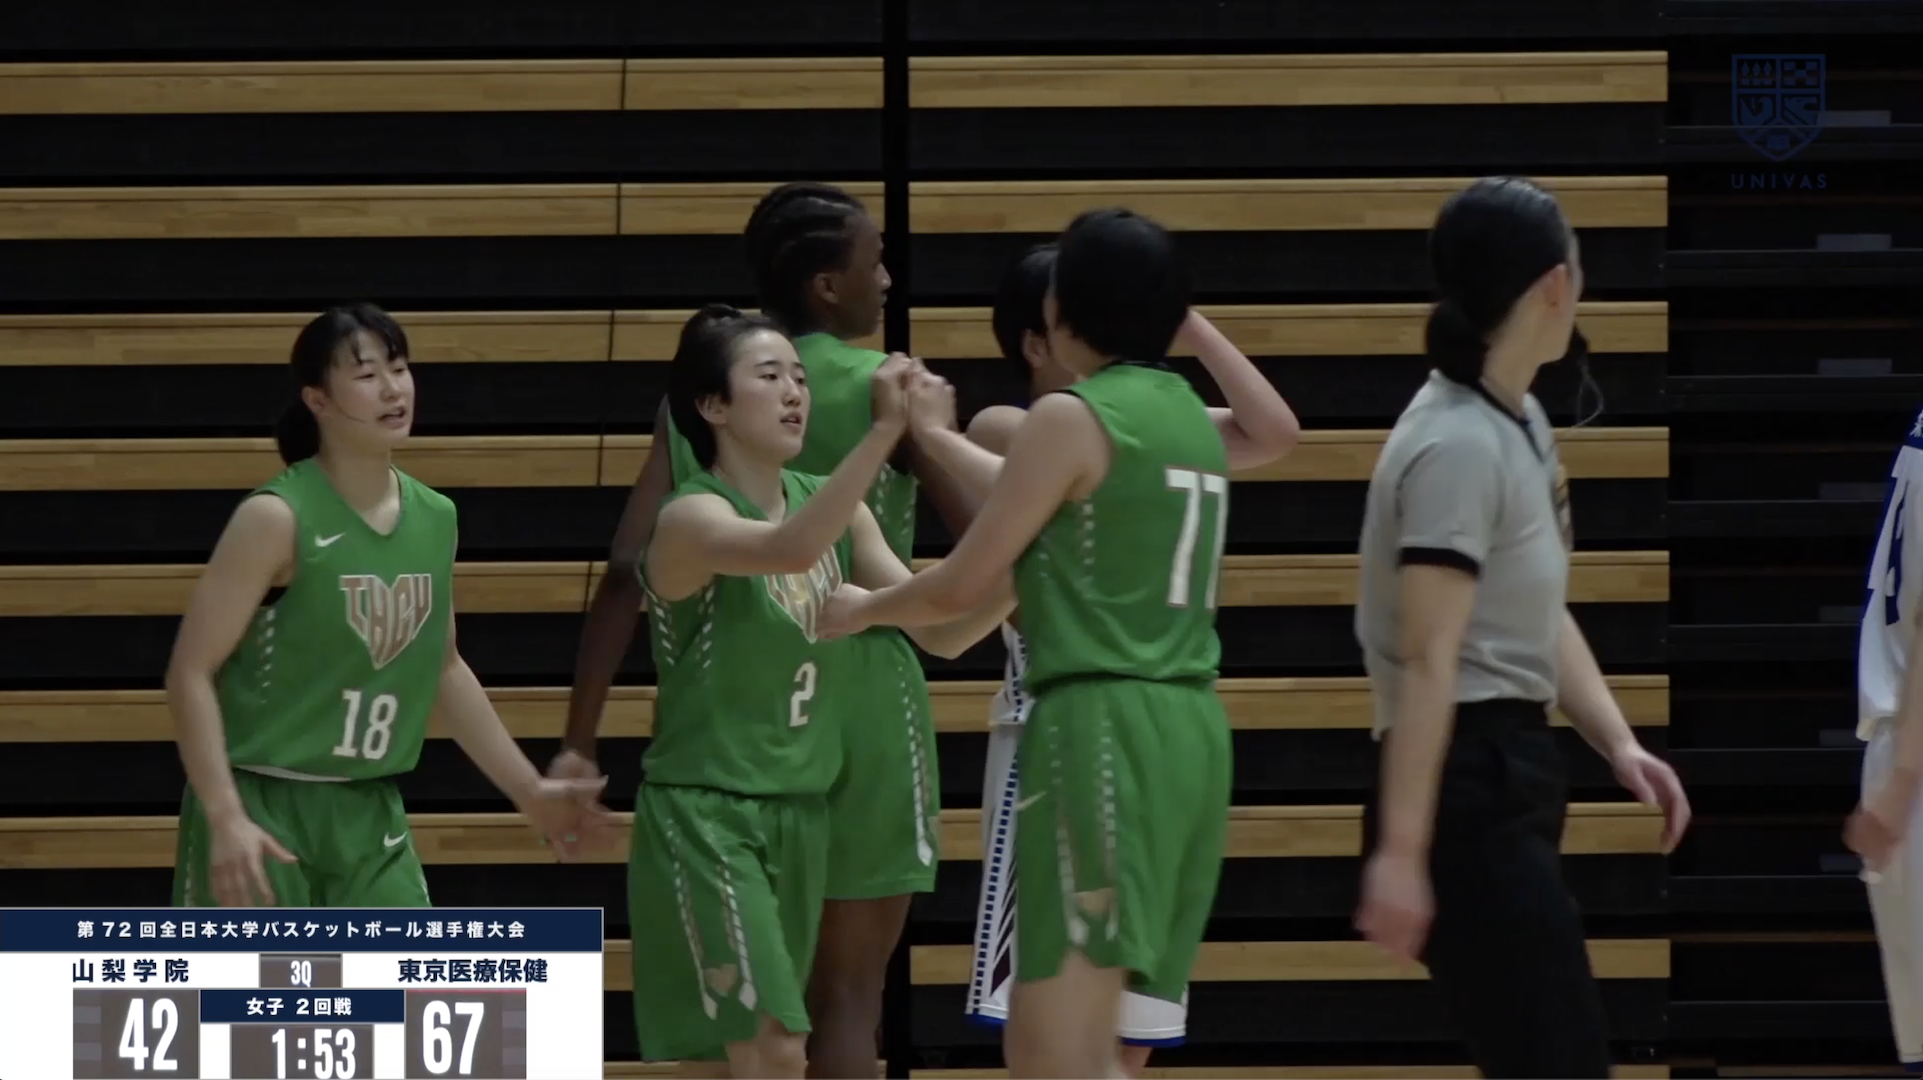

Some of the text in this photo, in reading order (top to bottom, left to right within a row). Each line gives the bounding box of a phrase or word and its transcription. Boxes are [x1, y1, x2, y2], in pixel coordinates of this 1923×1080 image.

[1165, 467, 1228, 611] 77
[332, 688, 399, 760] 18
[788, 661, 818, 728] 2
